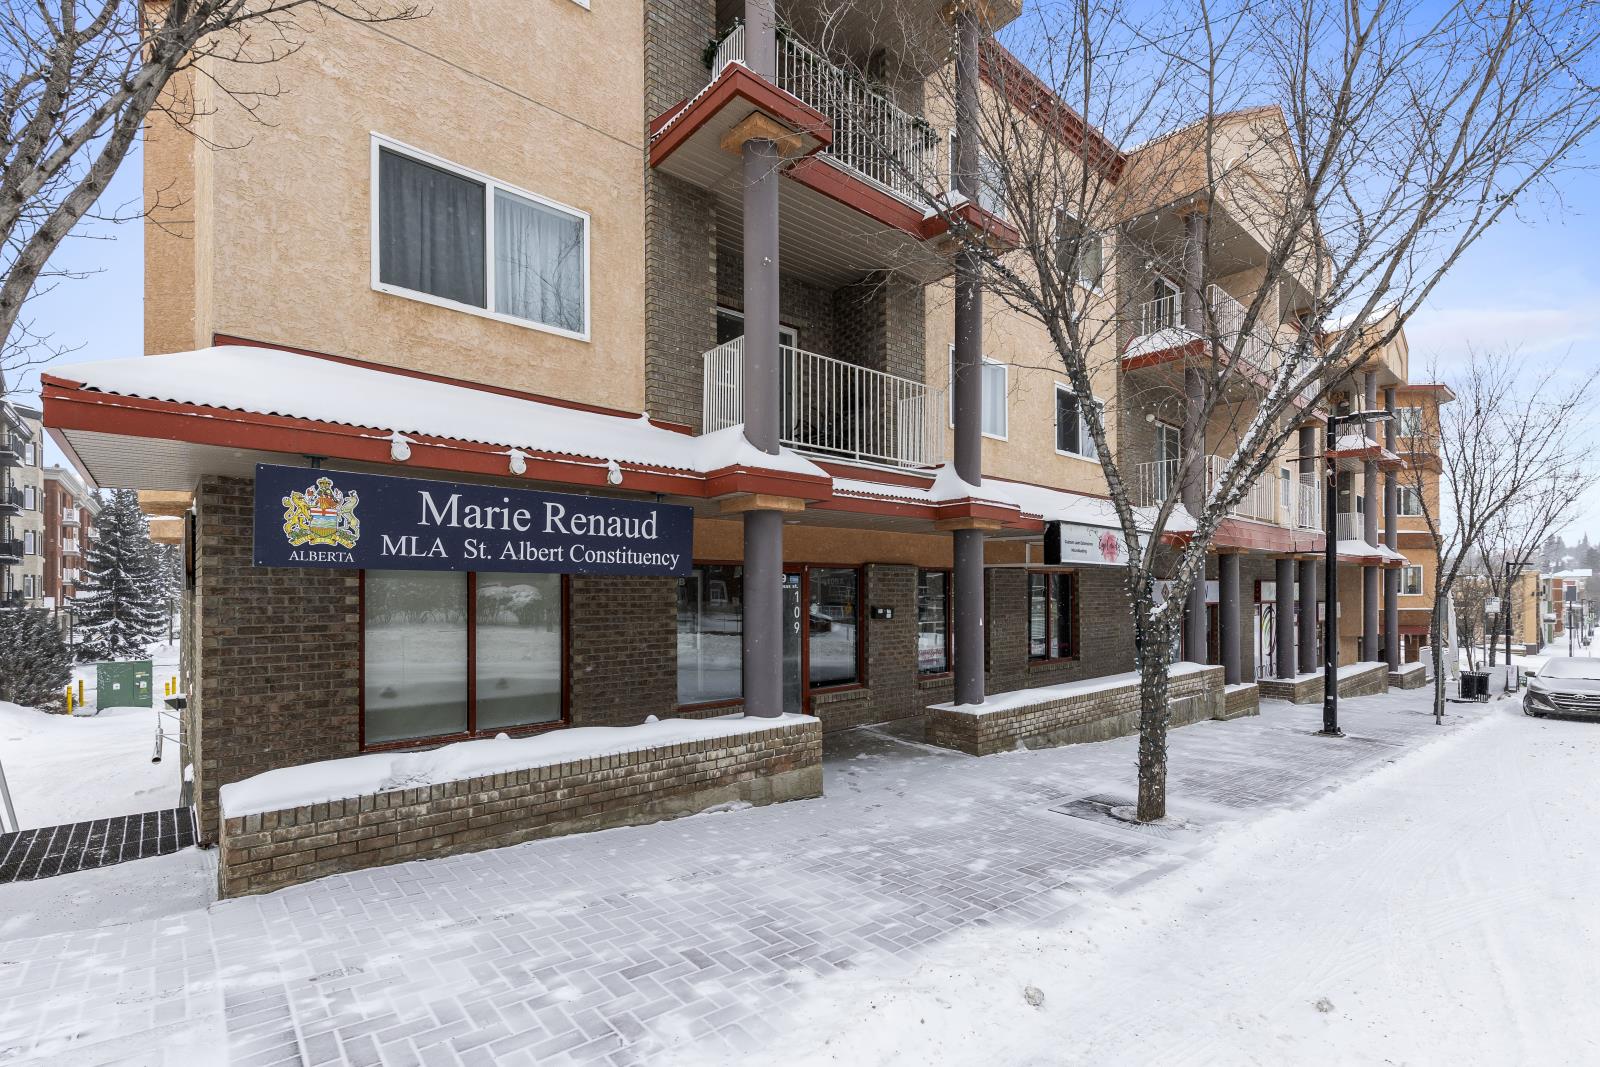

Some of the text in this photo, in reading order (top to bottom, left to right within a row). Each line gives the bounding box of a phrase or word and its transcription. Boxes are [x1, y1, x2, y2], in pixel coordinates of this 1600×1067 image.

[417, 490, 659, 541] Marie Renaud
[288, 550, 356, 564] ALBERTA
[380, 534, 449, 559] MLA
[463, 538, 493, 560] St.
[498, 540, 564, 563] Albert
[569, 543, 681, 571] Constituency
[793, 590, 801, 634] 109
